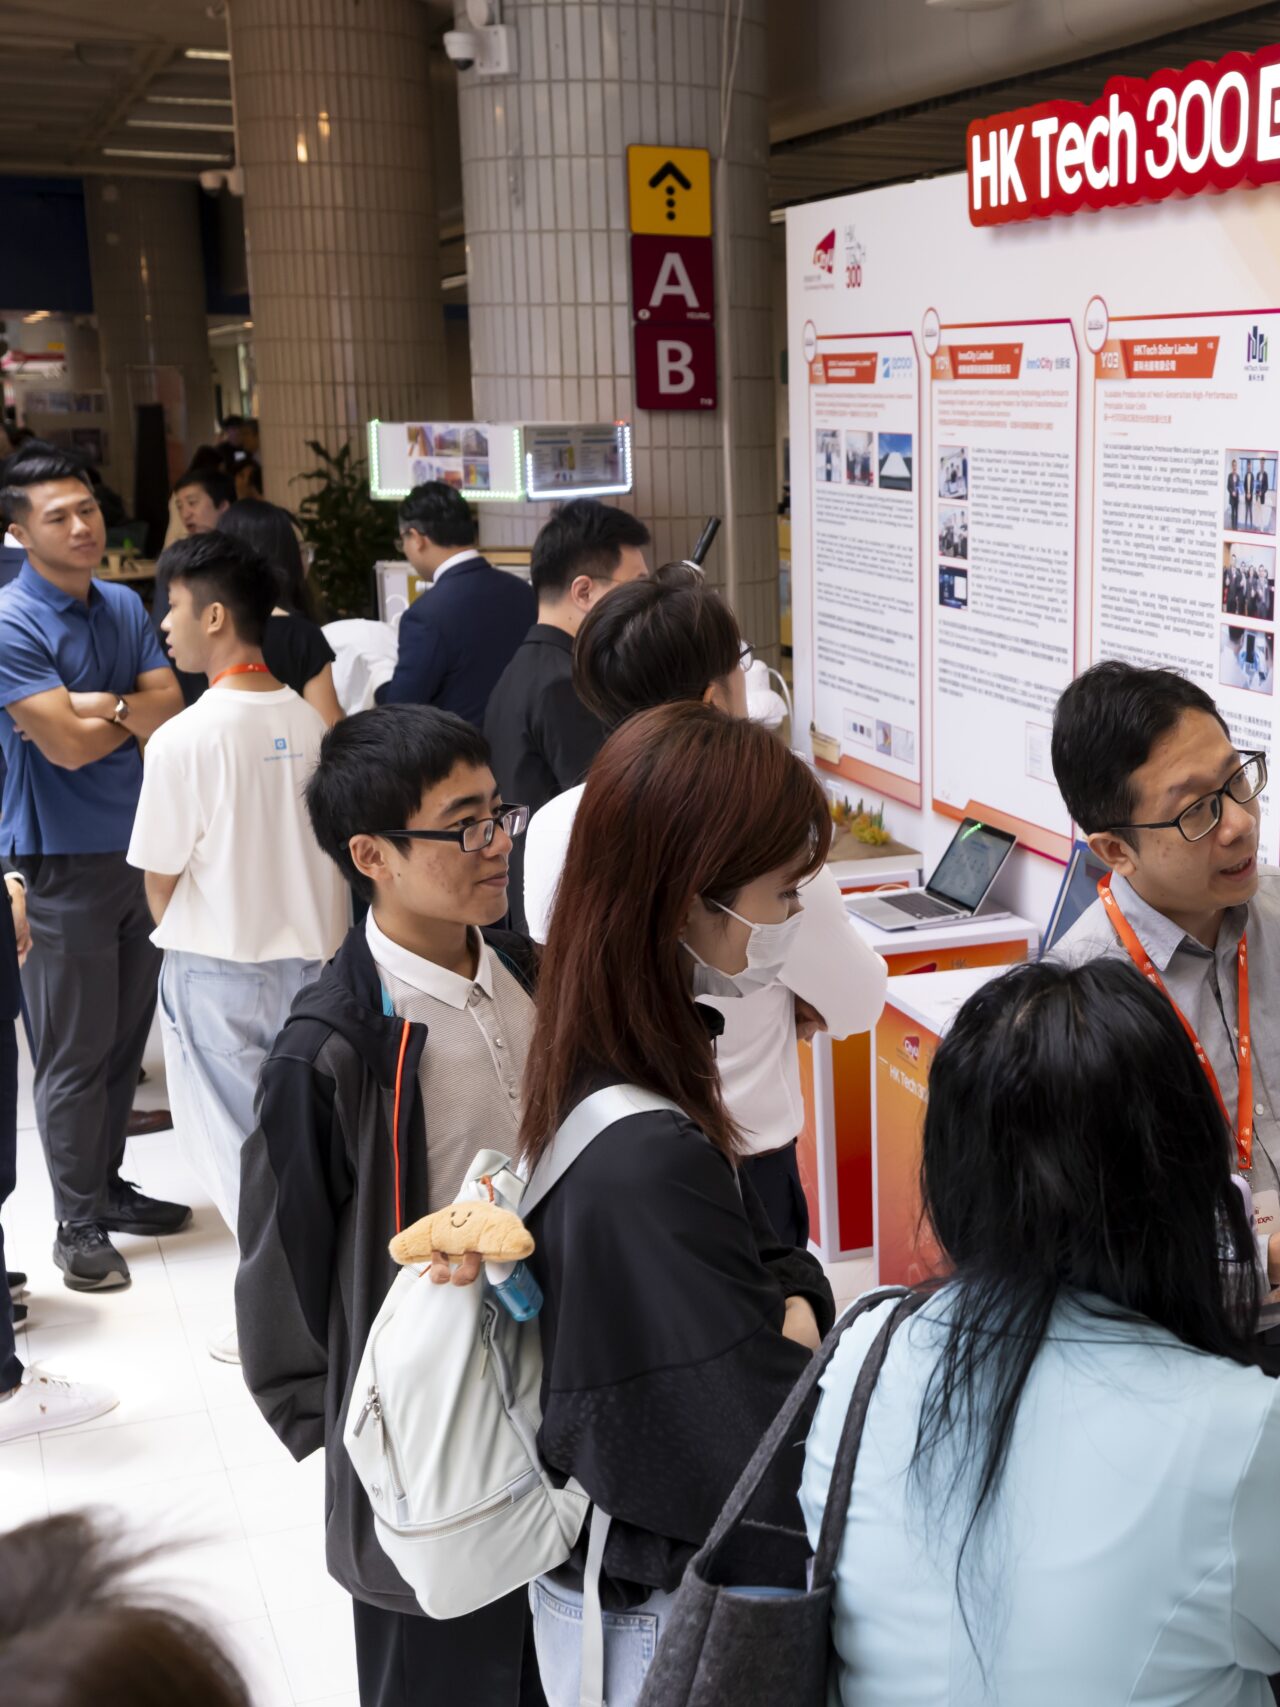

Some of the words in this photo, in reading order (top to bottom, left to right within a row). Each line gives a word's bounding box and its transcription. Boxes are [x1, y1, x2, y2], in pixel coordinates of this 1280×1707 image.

[971, 125, 1027, 210] HK
[1034, 94, 1137, 199] Tech
[1145, 71, 1249, 180] 300
[649, 252, 700, 308] A
[656, 339, 696, 395] B
